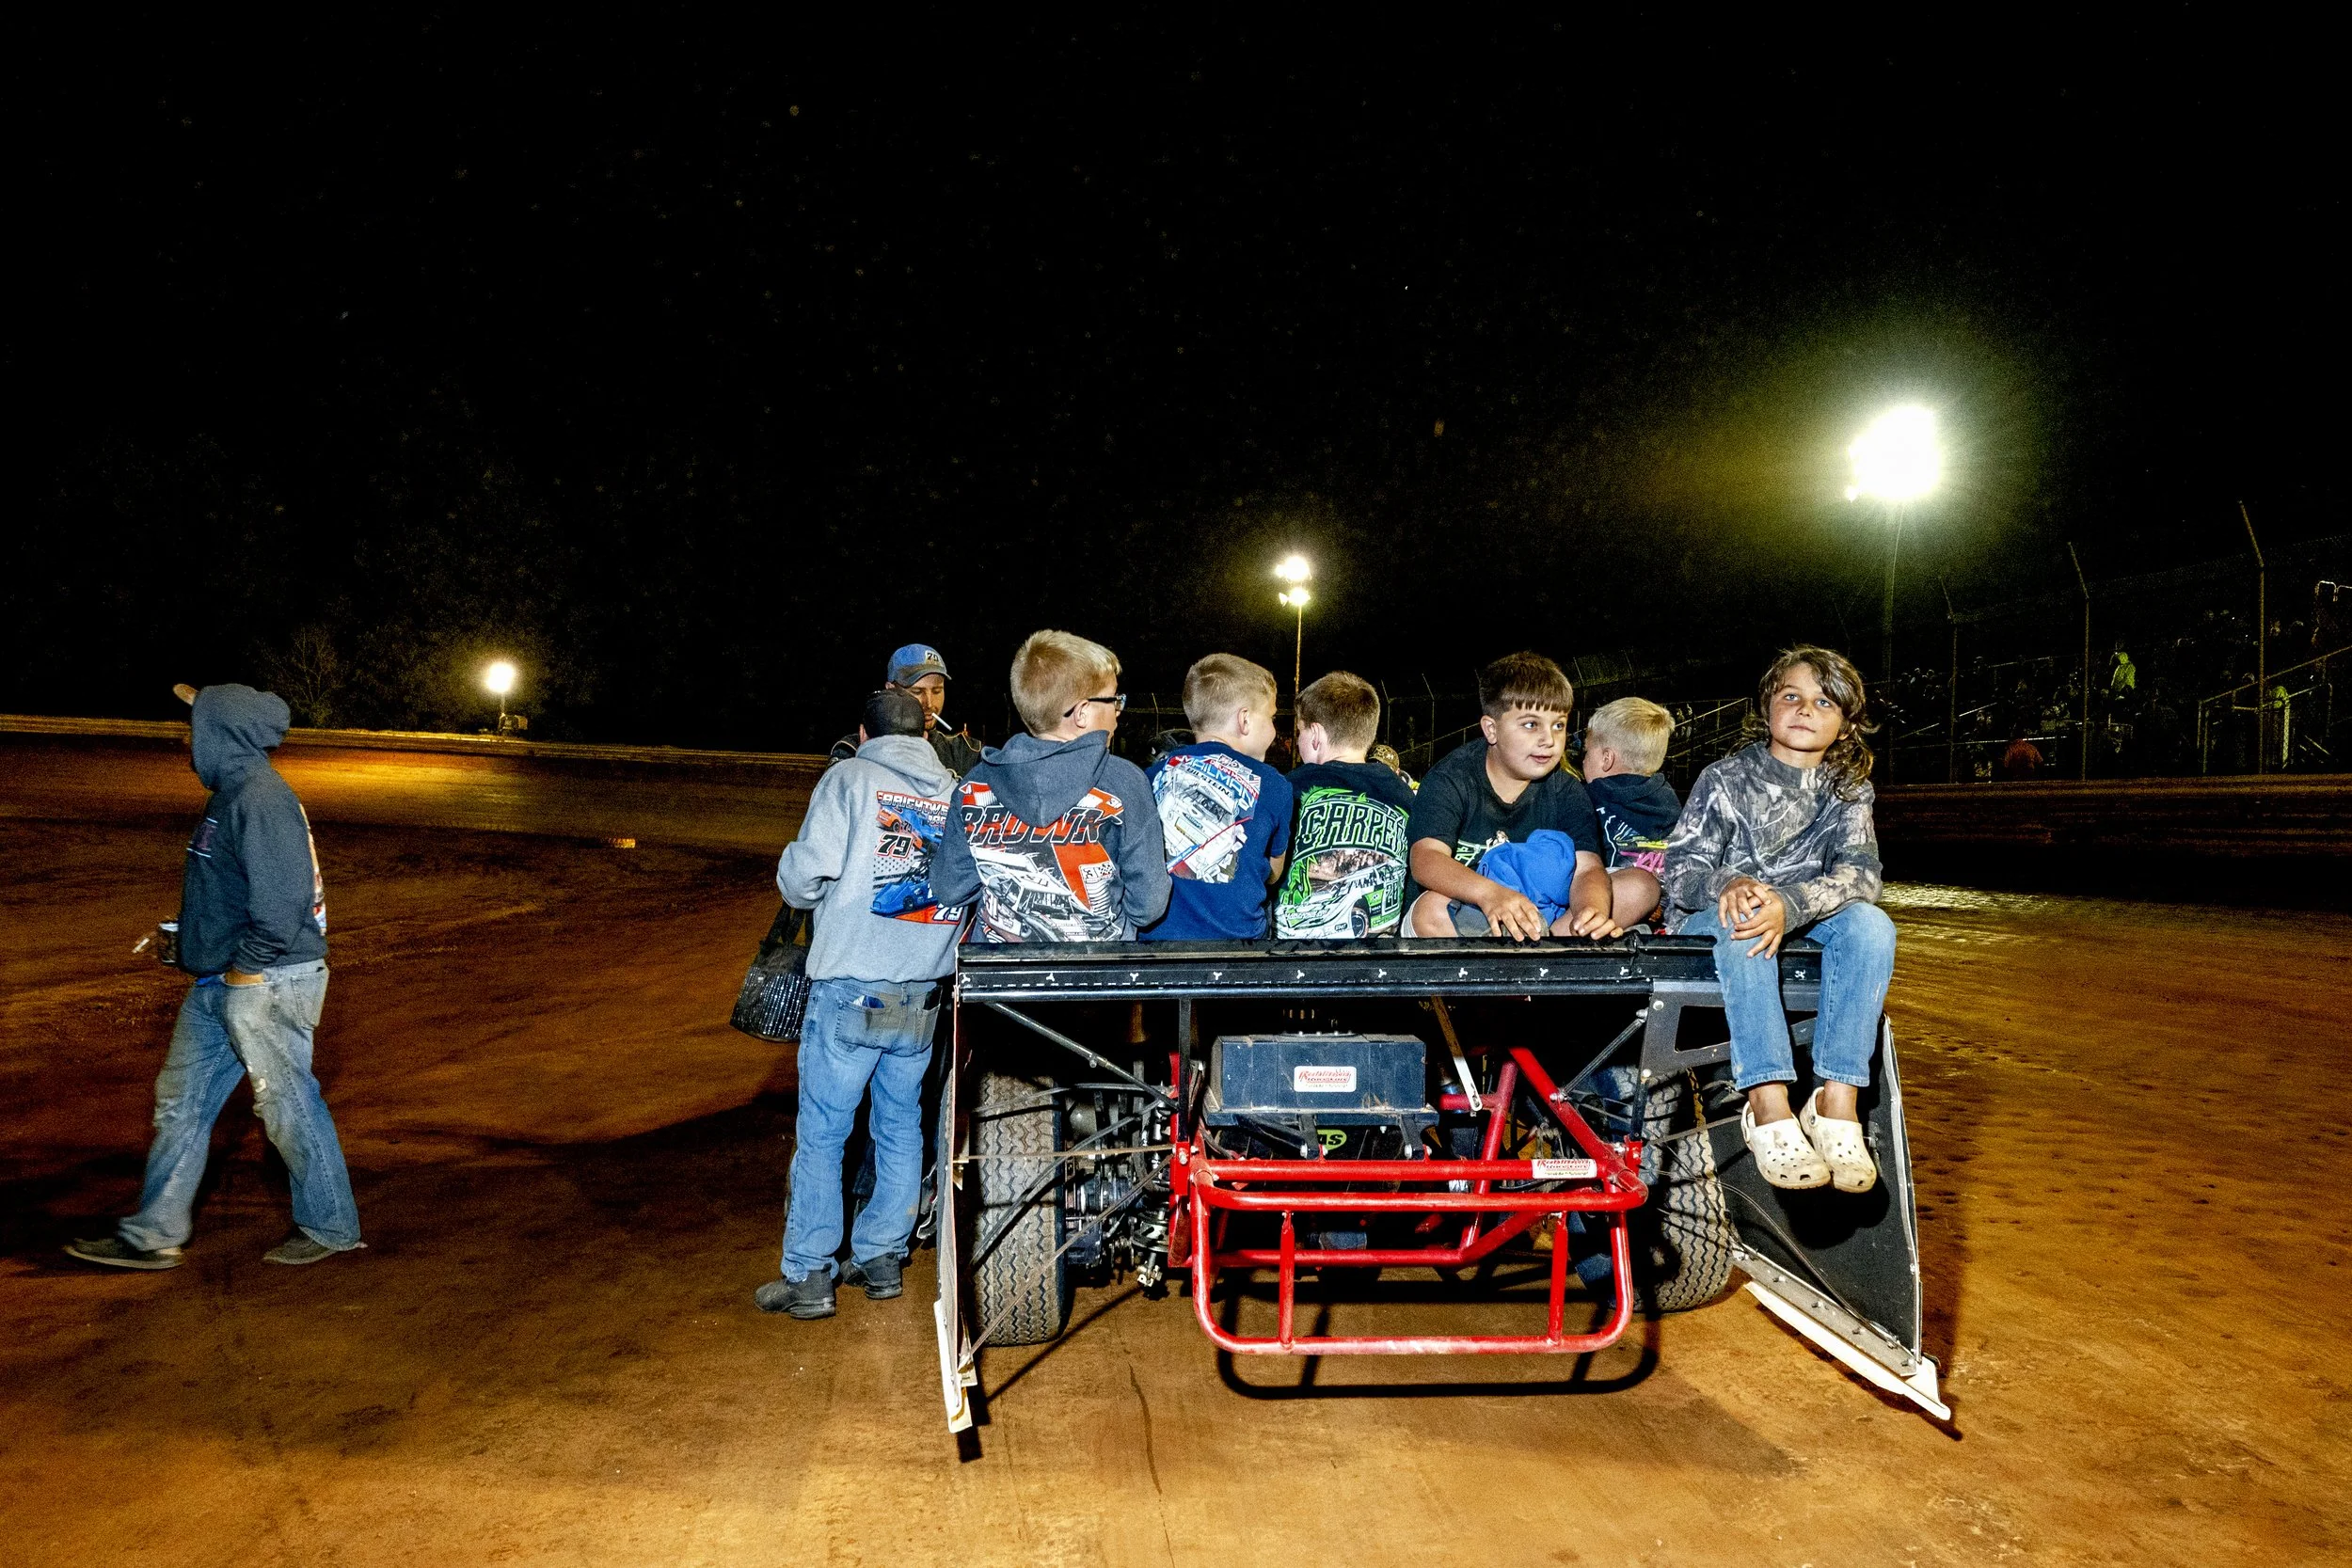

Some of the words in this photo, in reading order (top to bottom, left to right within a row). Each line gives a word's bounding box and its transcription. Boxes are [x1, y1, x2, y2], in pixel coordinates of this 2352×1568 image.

[927, 652, 939, 662] 79
[1176, 755, 1256, 808] MAILMAN
[876, 832, 913, 857] 79
[933, 903, 962, 921] 79
